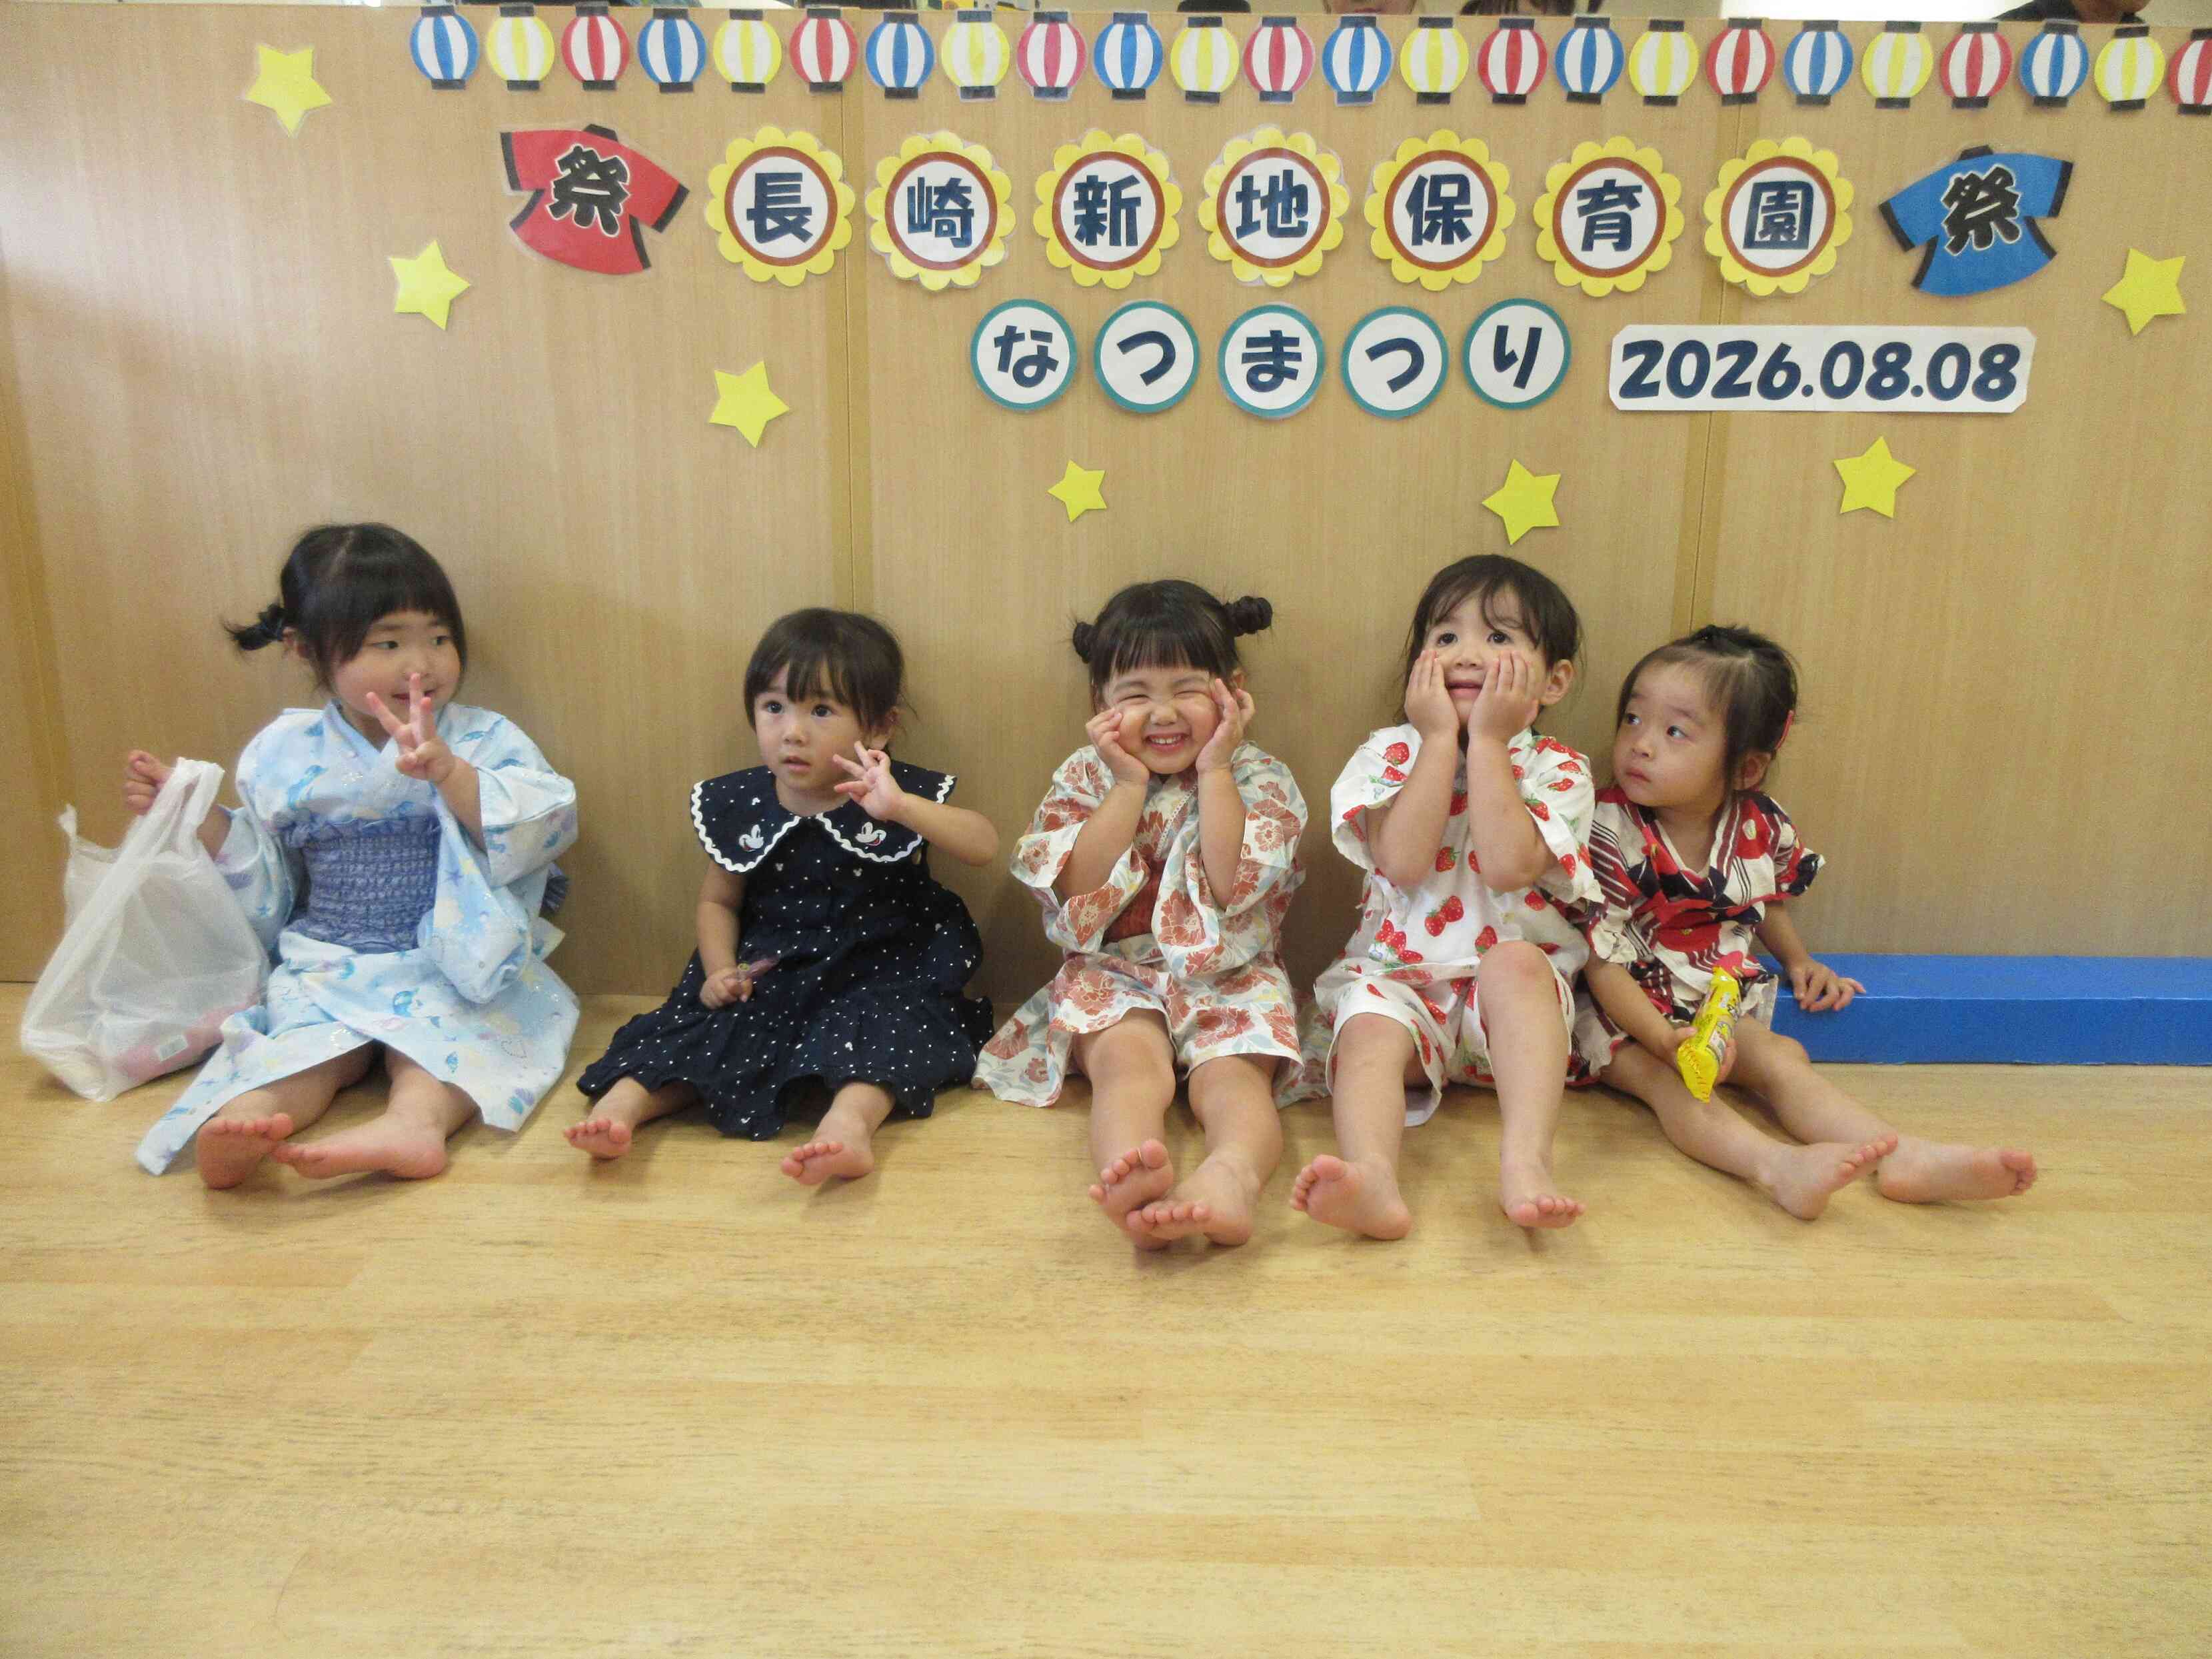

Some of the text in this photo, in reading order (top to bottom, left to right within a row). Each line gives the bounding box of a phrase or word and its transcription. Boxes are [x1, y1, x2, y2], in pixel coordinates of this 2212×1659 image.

[550, 144, 630, 235] 祭
[746, 169, 1814, 253] 長崎新地保育園
[1941, 164, 2021, 256] 祭
[994, 324, 1542, 393] なつまつり
[1619, 339, 2021, 402] 2026.08.08
